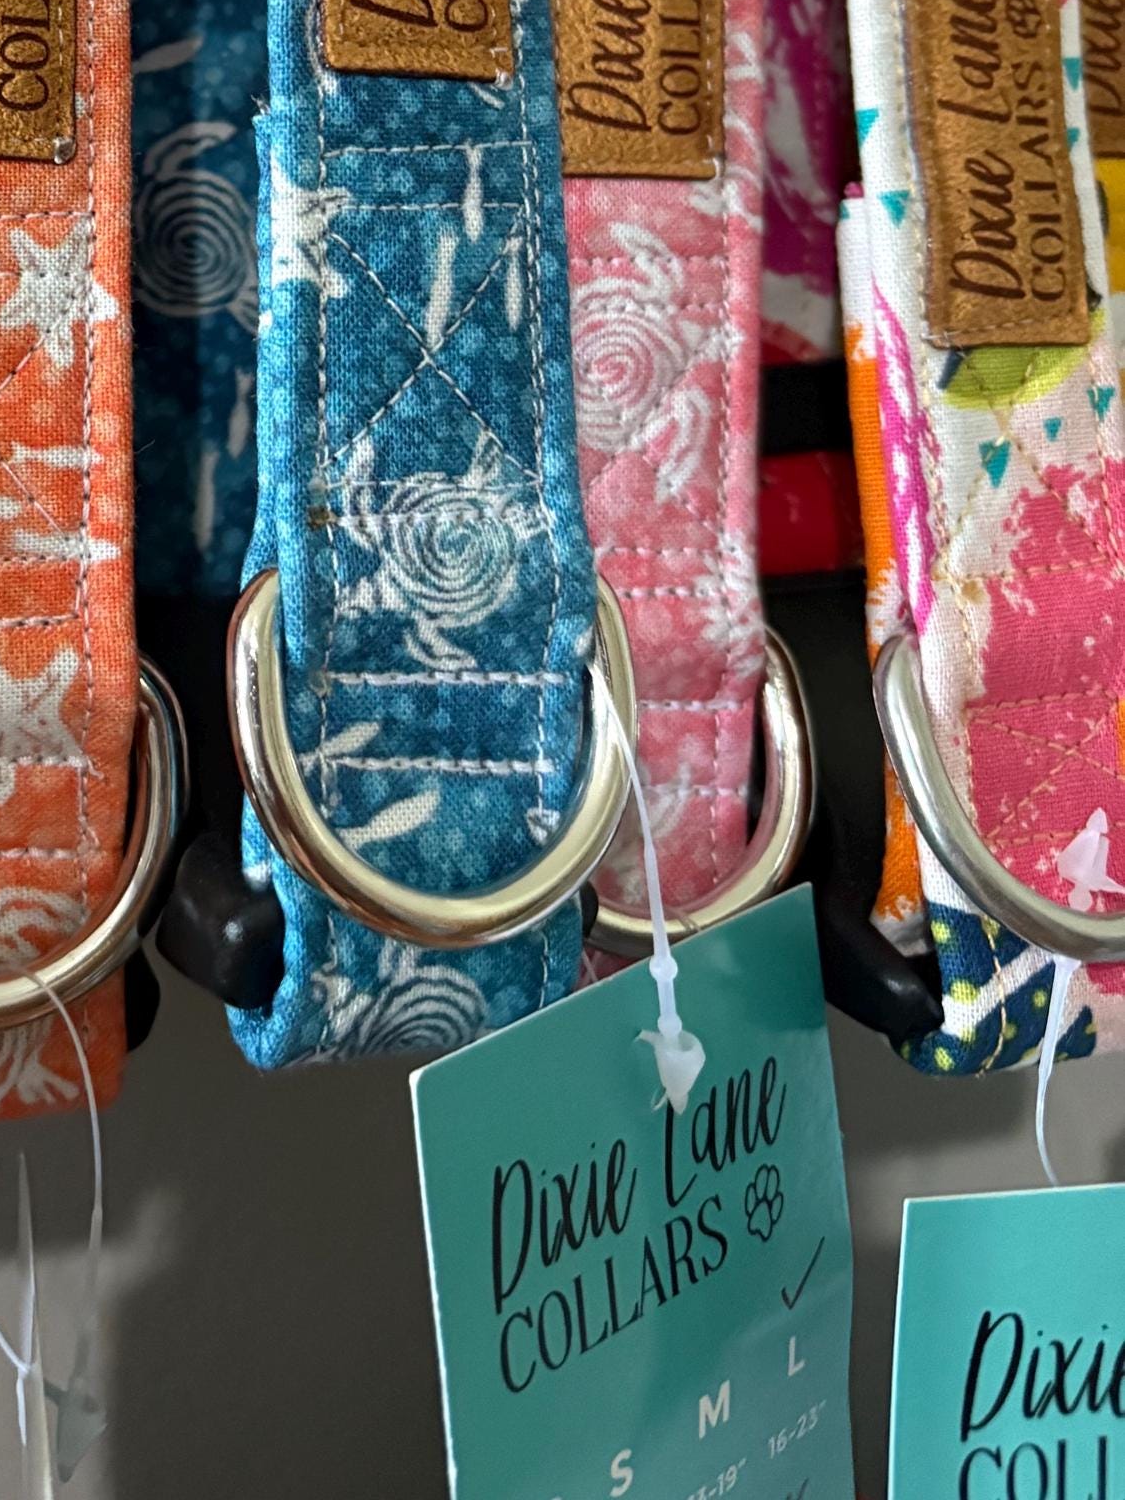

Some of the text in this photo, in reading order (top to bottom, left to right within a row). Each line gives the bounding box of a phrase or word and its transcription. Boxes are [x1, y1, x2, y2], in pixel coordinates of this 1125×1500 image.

[949, 148, 1027, 303] Dixie
[1012, 58, 1069, 303] COLLARS
[492, 1055, 788, 1315] Dixie Lane
[498, 1194, 729, 1394] COLLARS
[609, 1335, 806, 1498] S M L
